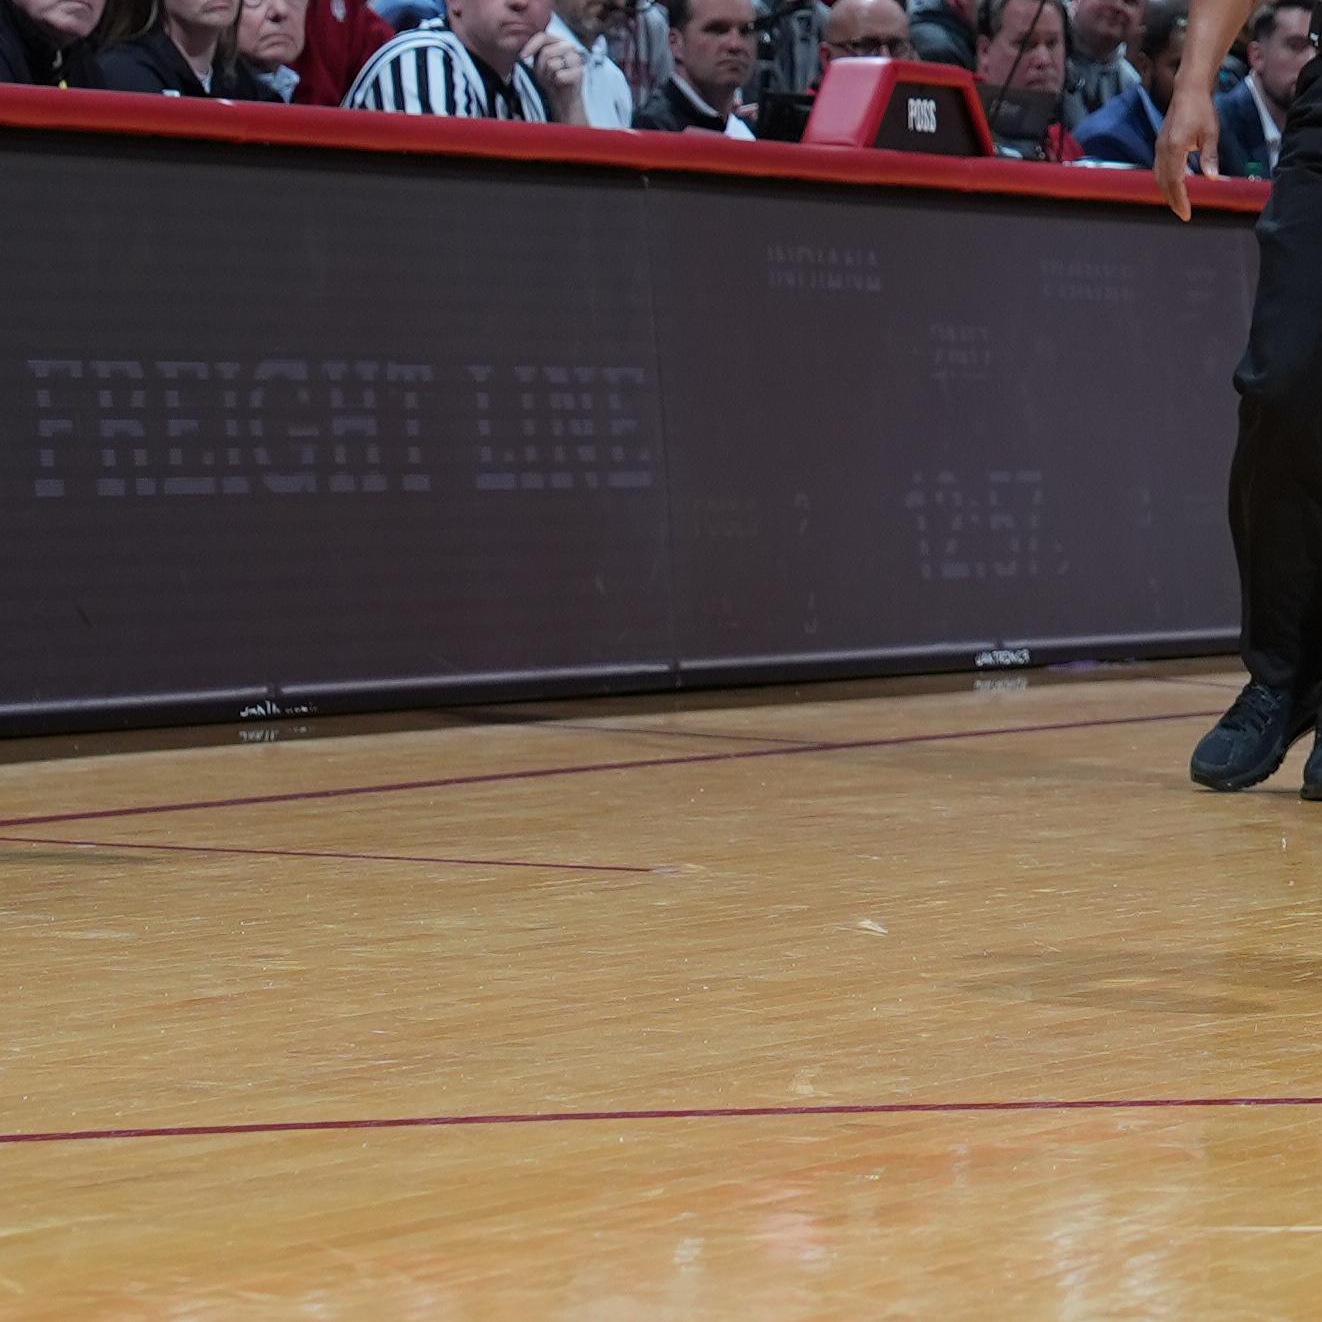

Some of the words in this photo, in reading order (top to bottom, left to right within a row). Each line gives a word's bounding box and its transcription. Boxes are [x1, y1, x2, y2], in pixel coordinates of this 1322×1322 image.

[907, 98, 937, 133] POSS
[26, 359, 432, 498] FREIGHT
[468, 364, 653, 491] LINE
